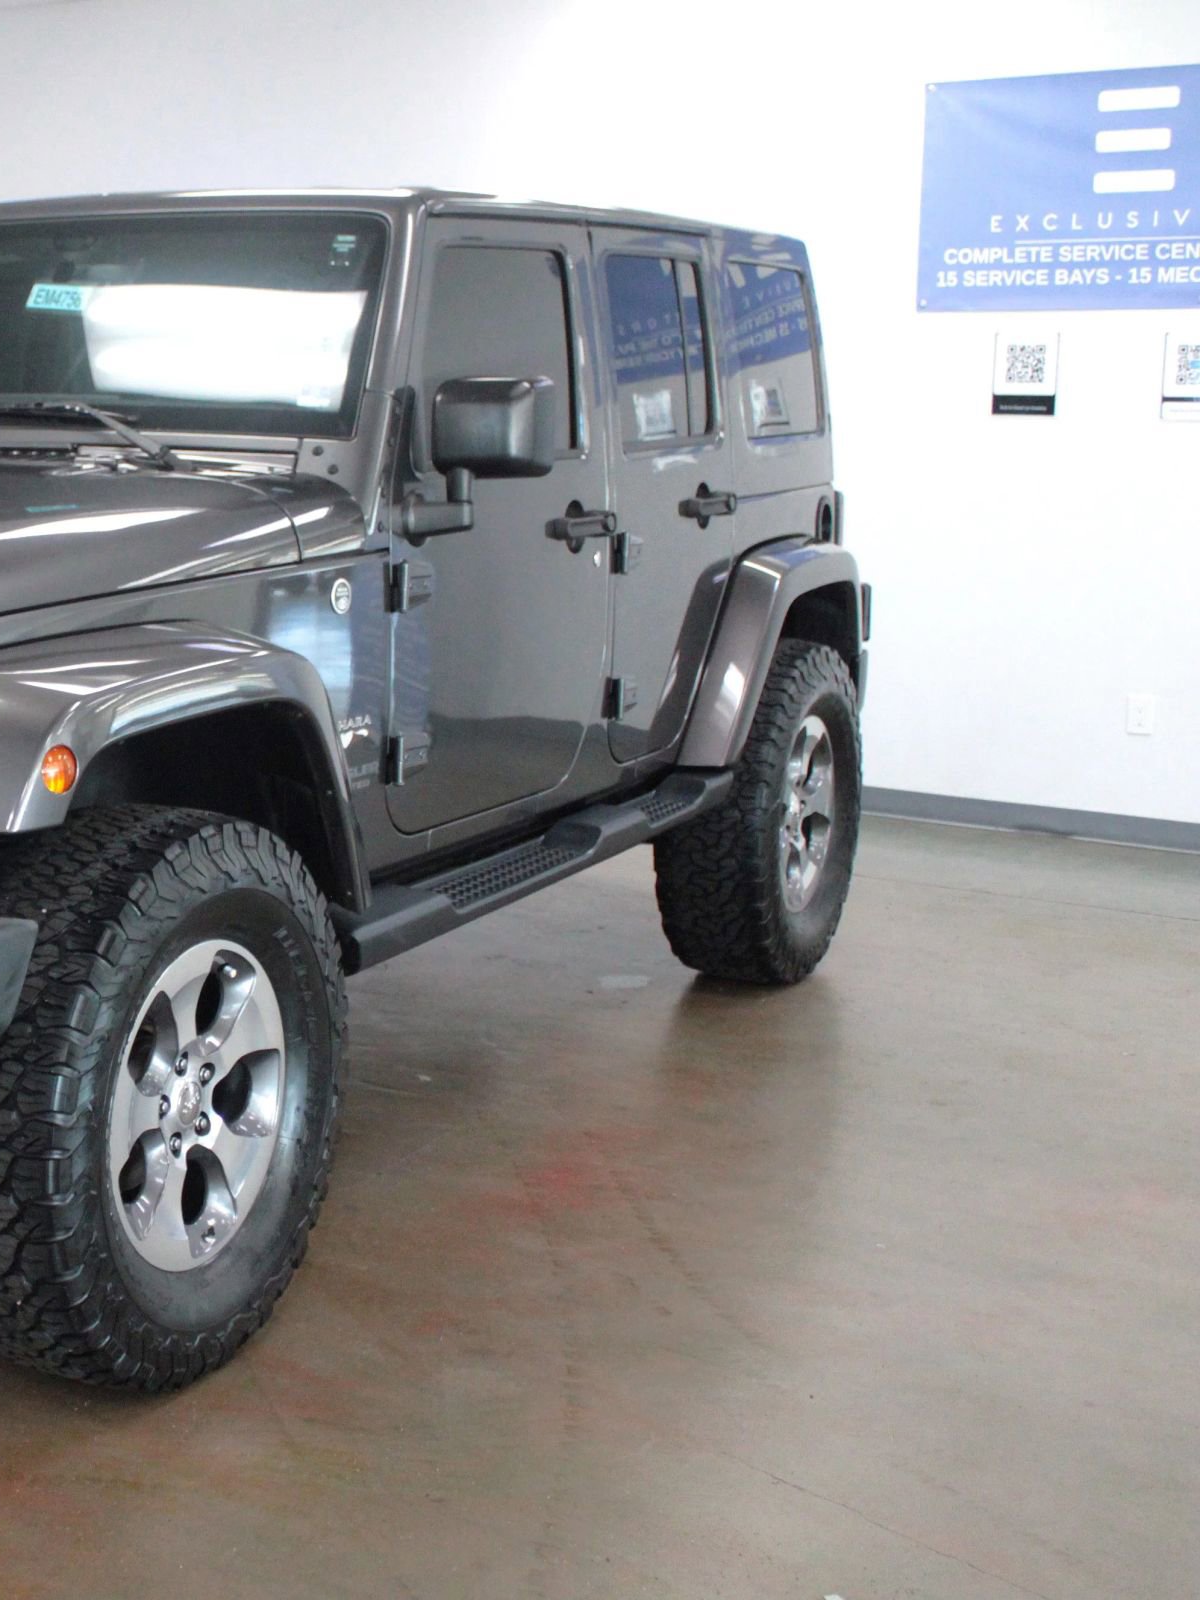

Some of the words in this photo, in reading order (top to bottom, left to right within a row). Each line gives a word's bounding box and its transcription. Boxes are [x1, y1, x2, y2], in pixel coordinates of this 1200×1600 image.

[990, 208, 1191, 233] EXCLUSIV
[943, 245, 1054, 265] COMPLETE
[1058, 243, 1149, 263] SERVICE
[1154, 242, 1200, 261] CEN
[936, 270, 958, 288] 15
[962, 268, 1049, 287] SERVICE
[1054, 267, 1110, 286] BAYS
[1127, 266, 1152, 285] 15
[1156, 265, 1200, 284] MEC
[337, 713, 372, 732] HARA
